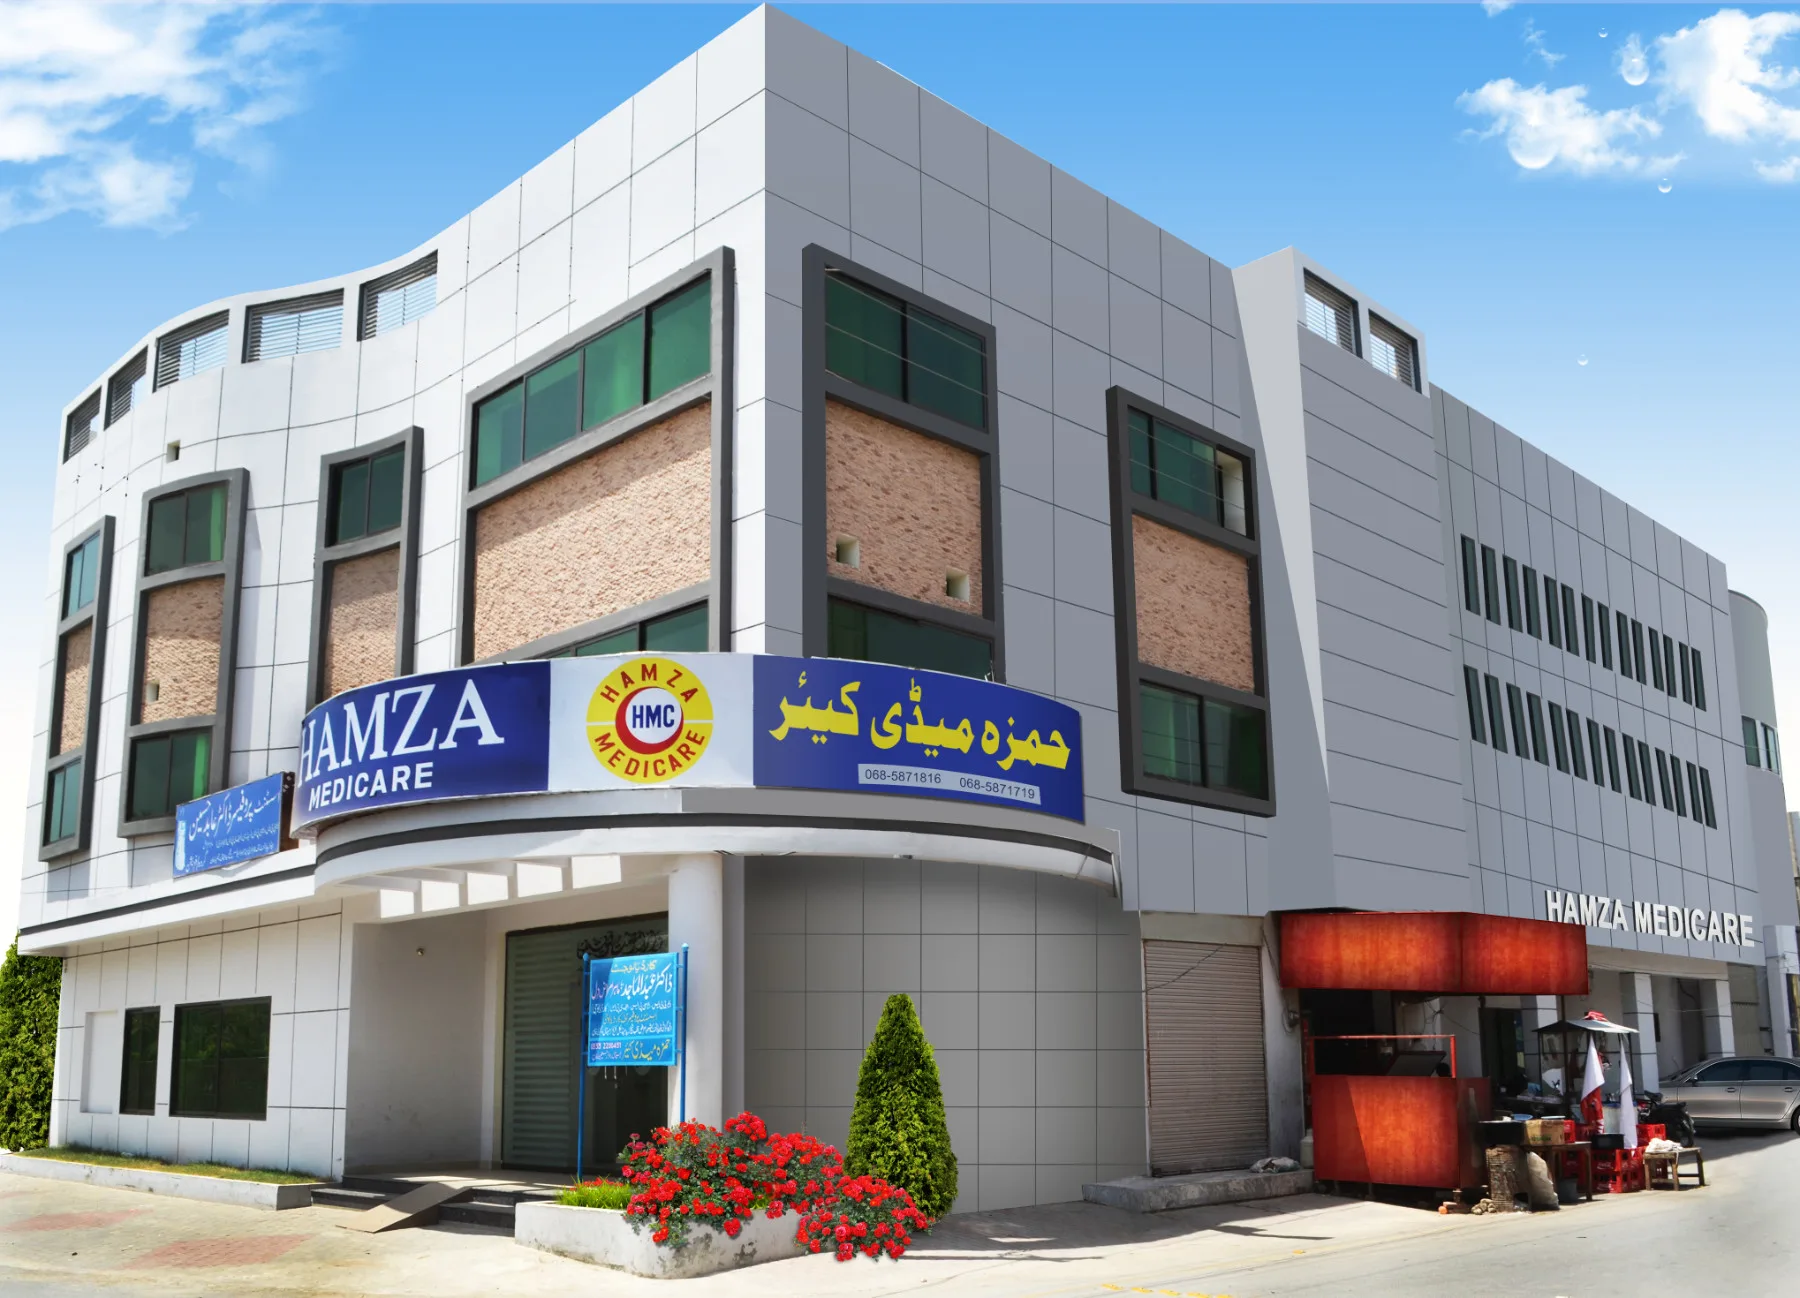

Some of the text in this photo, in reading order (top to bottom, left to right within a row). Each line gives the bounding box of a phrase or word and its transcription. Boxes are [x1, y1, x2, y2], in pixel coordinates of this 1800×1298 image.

[600, 663, 699, 703] HAMZA
[298, 679, 505, 788] HAMZA
[632, 704, 675, 729] HMC
[870, 677, 975, 758] میڈی
[594, 729, 705, 778] MEDICARE
[981, 716, 1071, 771] حمزہ
[308, 761, 434, 811] MEDICARE
[864, 768, 1036, 800] 068-5871816 068-5871719
[1545, 889, 1755, 948] HAMZA MEDICARE
